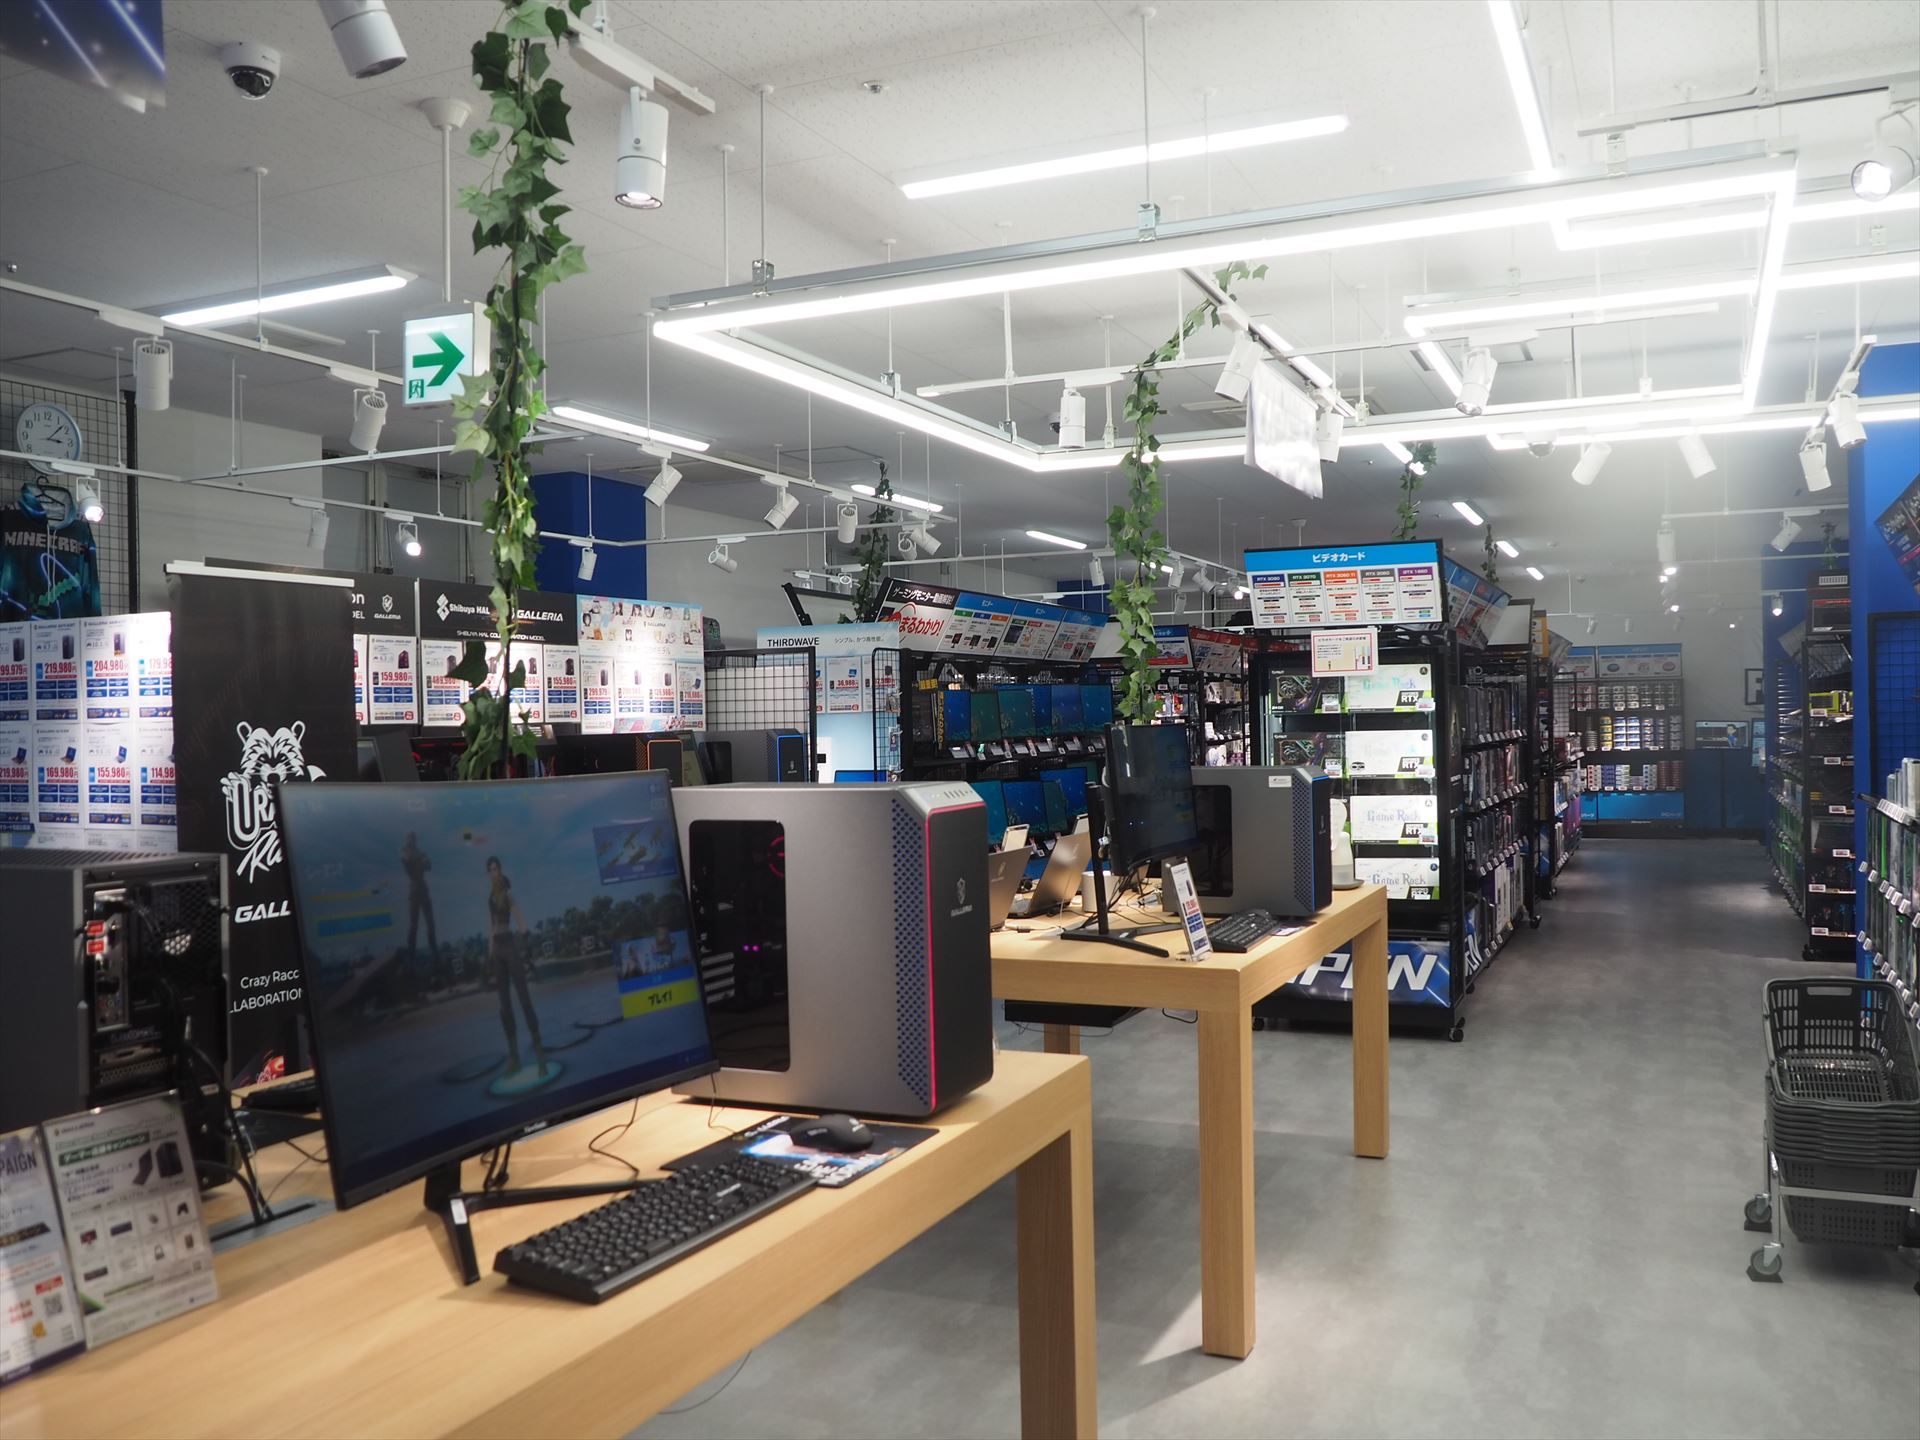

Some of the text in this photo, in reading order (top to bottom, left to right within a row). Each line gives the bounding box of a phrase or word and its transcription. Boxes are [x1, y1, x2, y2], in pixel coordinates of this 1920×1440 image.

[43, 412, 52, 421] 12
[25, 420, 33, 429] 10
[22, 431, 29, 441] 9
[64, 426, 70, 435] 2
[67, 438, 74, 448] 3
[1312, 551, 1366, 564] ビデオカード
[449, 603, 490, 615] Shibuya HAL
[516, 610, 564, 622] GALLERIA
[898, 616, 945, 637] まるわかり!
[767, 637, 820, 648] THIRDWAVE
[1401, 695, 1418, 703] RTX
[1371, 873, 1400, 886] Game
[240, 975, 271, 989] Crazy
